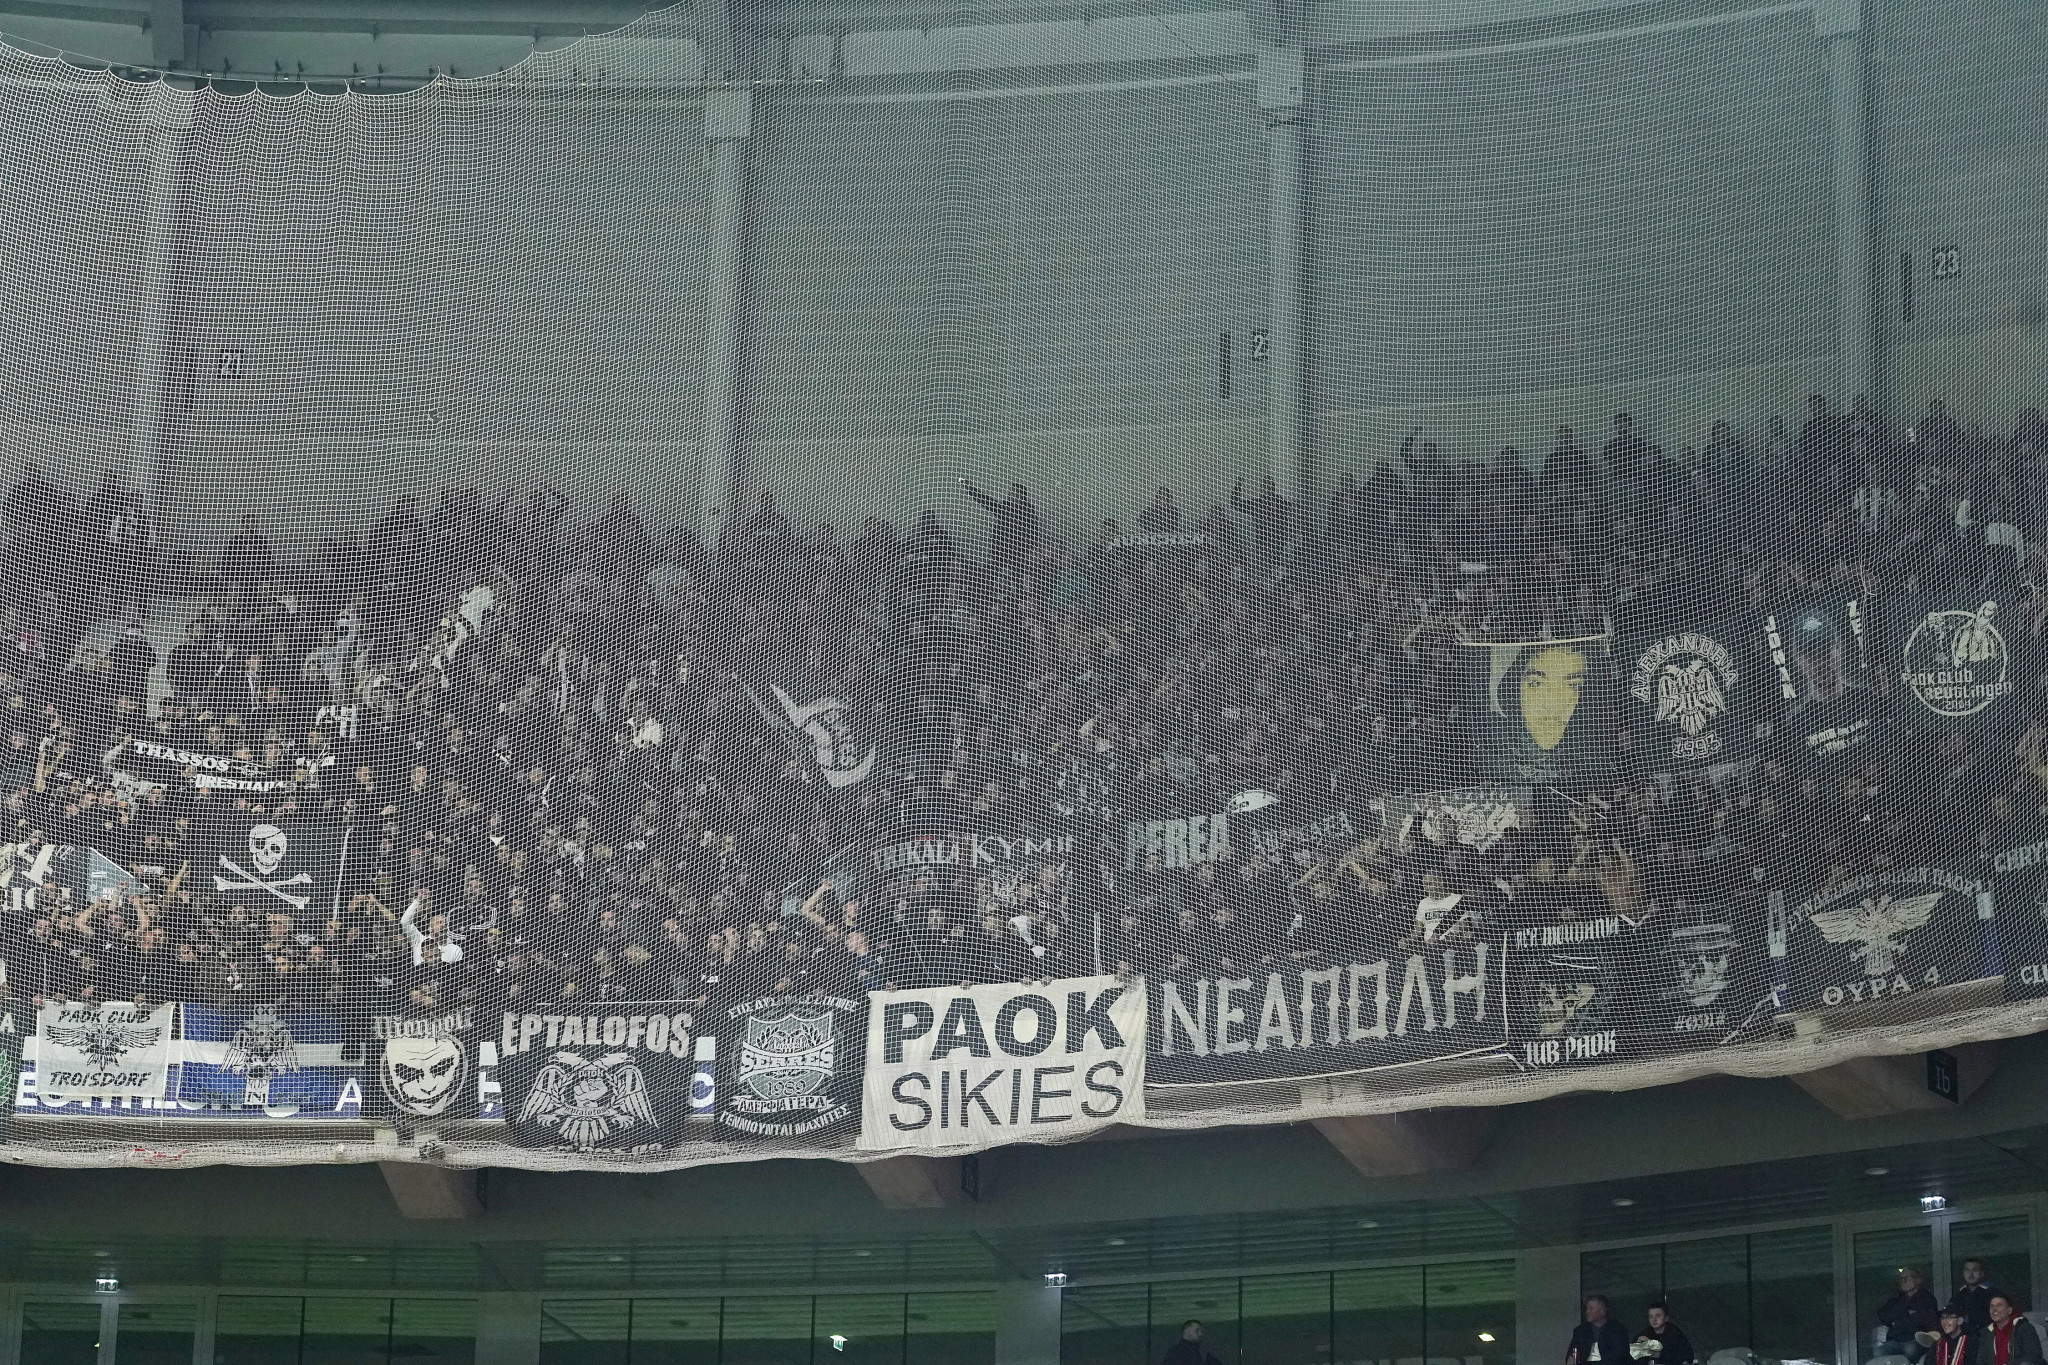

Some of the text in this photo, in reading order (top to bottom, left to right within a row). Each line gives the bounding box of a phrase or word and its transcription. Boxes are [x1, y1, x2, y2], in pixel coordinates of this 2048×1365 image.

[1934, 250, 1958, 275] 23
[221, 352, 241, 376] 21
[1631, 633, 1738, 703] ALEXANDRIA
[133, 740, 230, 772] THASSOS
[1822, 966, 1940, 1006] ΘΥΡΑ 4
[58, 1010, 151, 1024] PAOK CLUB
[883, 987, 1126, 1064] PAOK
[501, 1011, 693, 1059] EPTALOFOS
[741, 1044, 834, 1074] SERRES
[49, 1070, 152, 1088] TROISDORF
[767, 1080, 806, 1096] 1989
[889, 1059, 1125, 1132] SIKIES
[795, 1103, 852, 1135] ΜΑΧΗΤΕΣ
